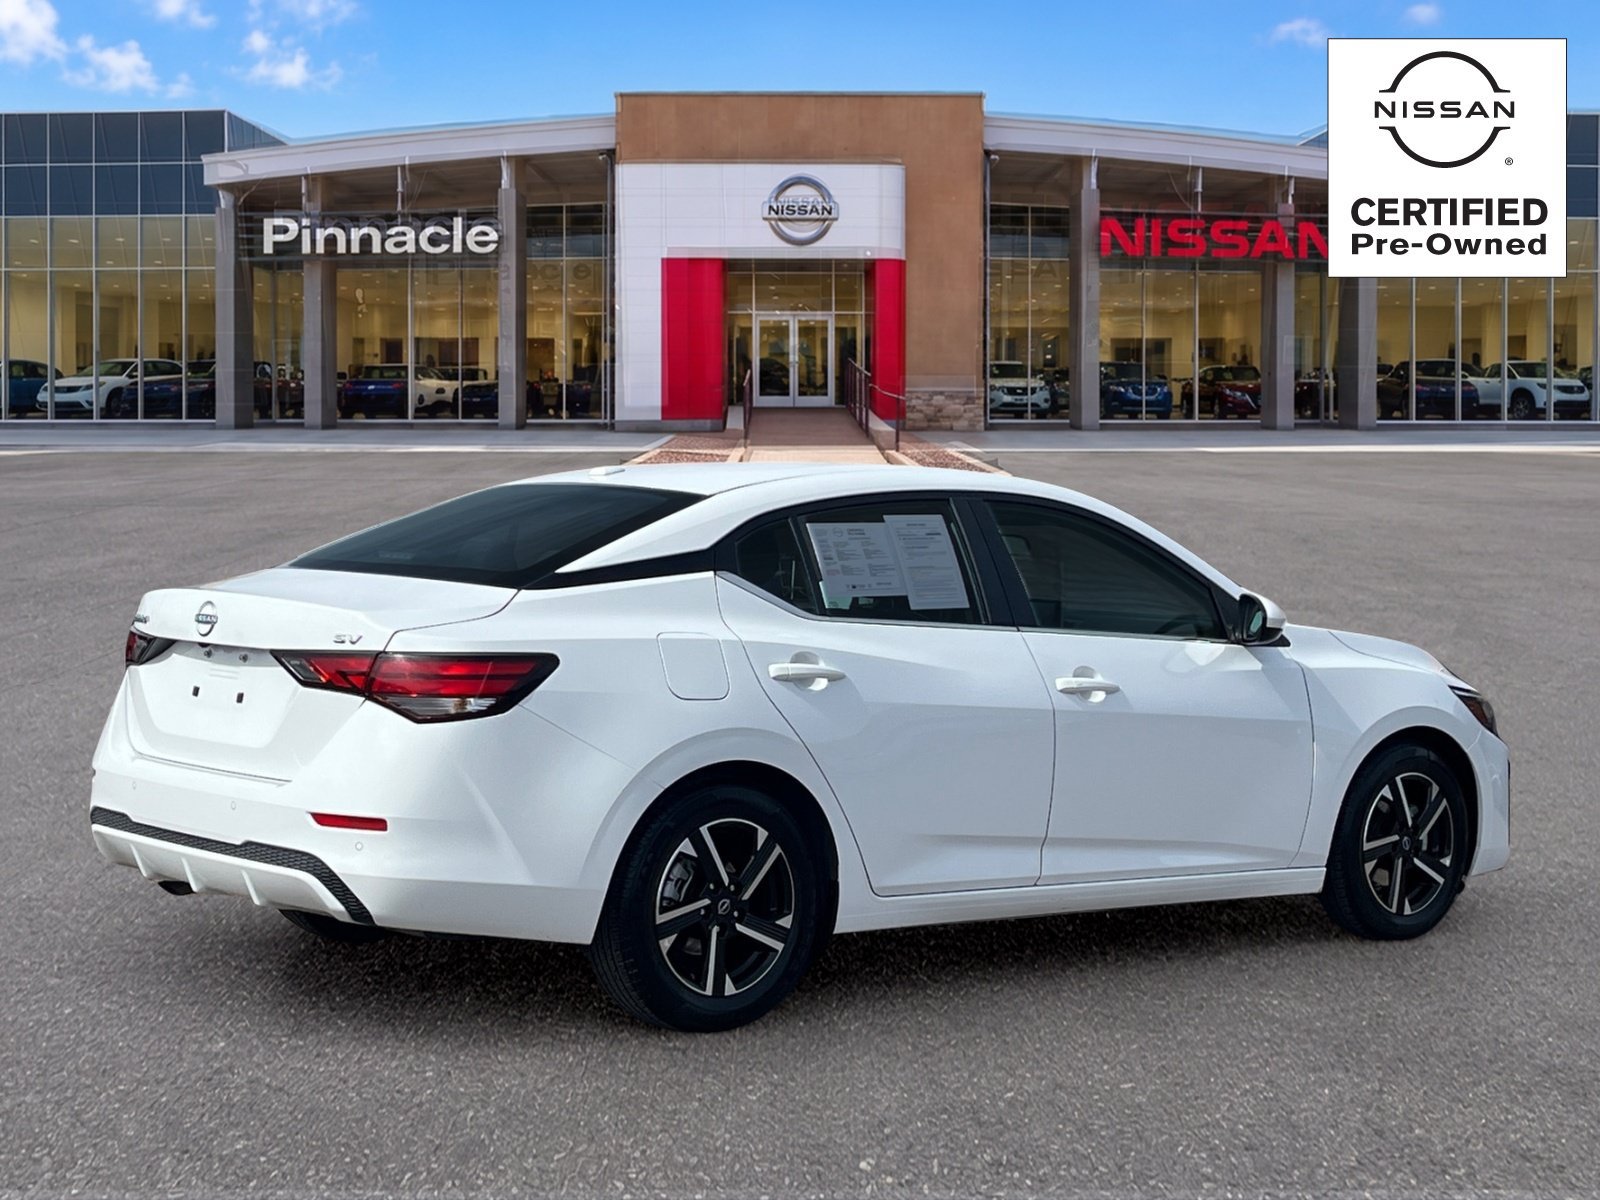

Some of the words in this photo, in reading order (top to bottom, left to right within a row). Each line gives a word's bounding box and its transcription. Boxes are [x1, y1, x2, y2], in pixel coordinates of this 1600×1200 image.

[768, 204, 833, 217] NISSAN
[262, 216, 499, 255] Pinnacle
[333, 634, 363, 645] SV
